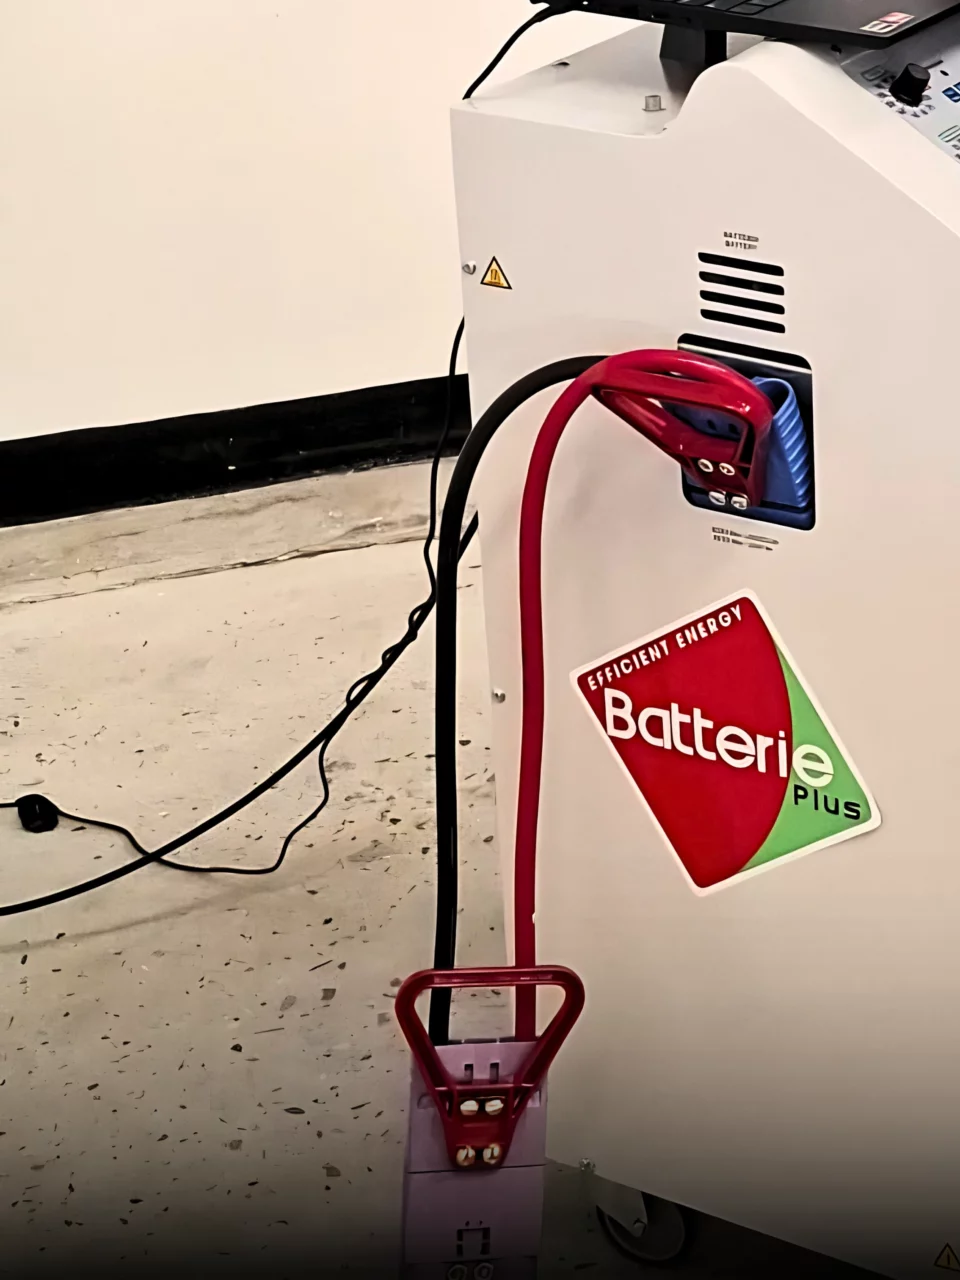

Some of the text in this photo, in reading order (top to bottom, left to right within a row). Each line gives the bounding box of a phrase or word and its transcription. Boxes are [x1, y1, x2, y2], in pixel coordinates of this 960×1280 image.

[587, 604, 743, 691] EFFICIENT ENERGY
[603, 687, 835, 789] Batterie
[793, 784, 861, 821] Plus
